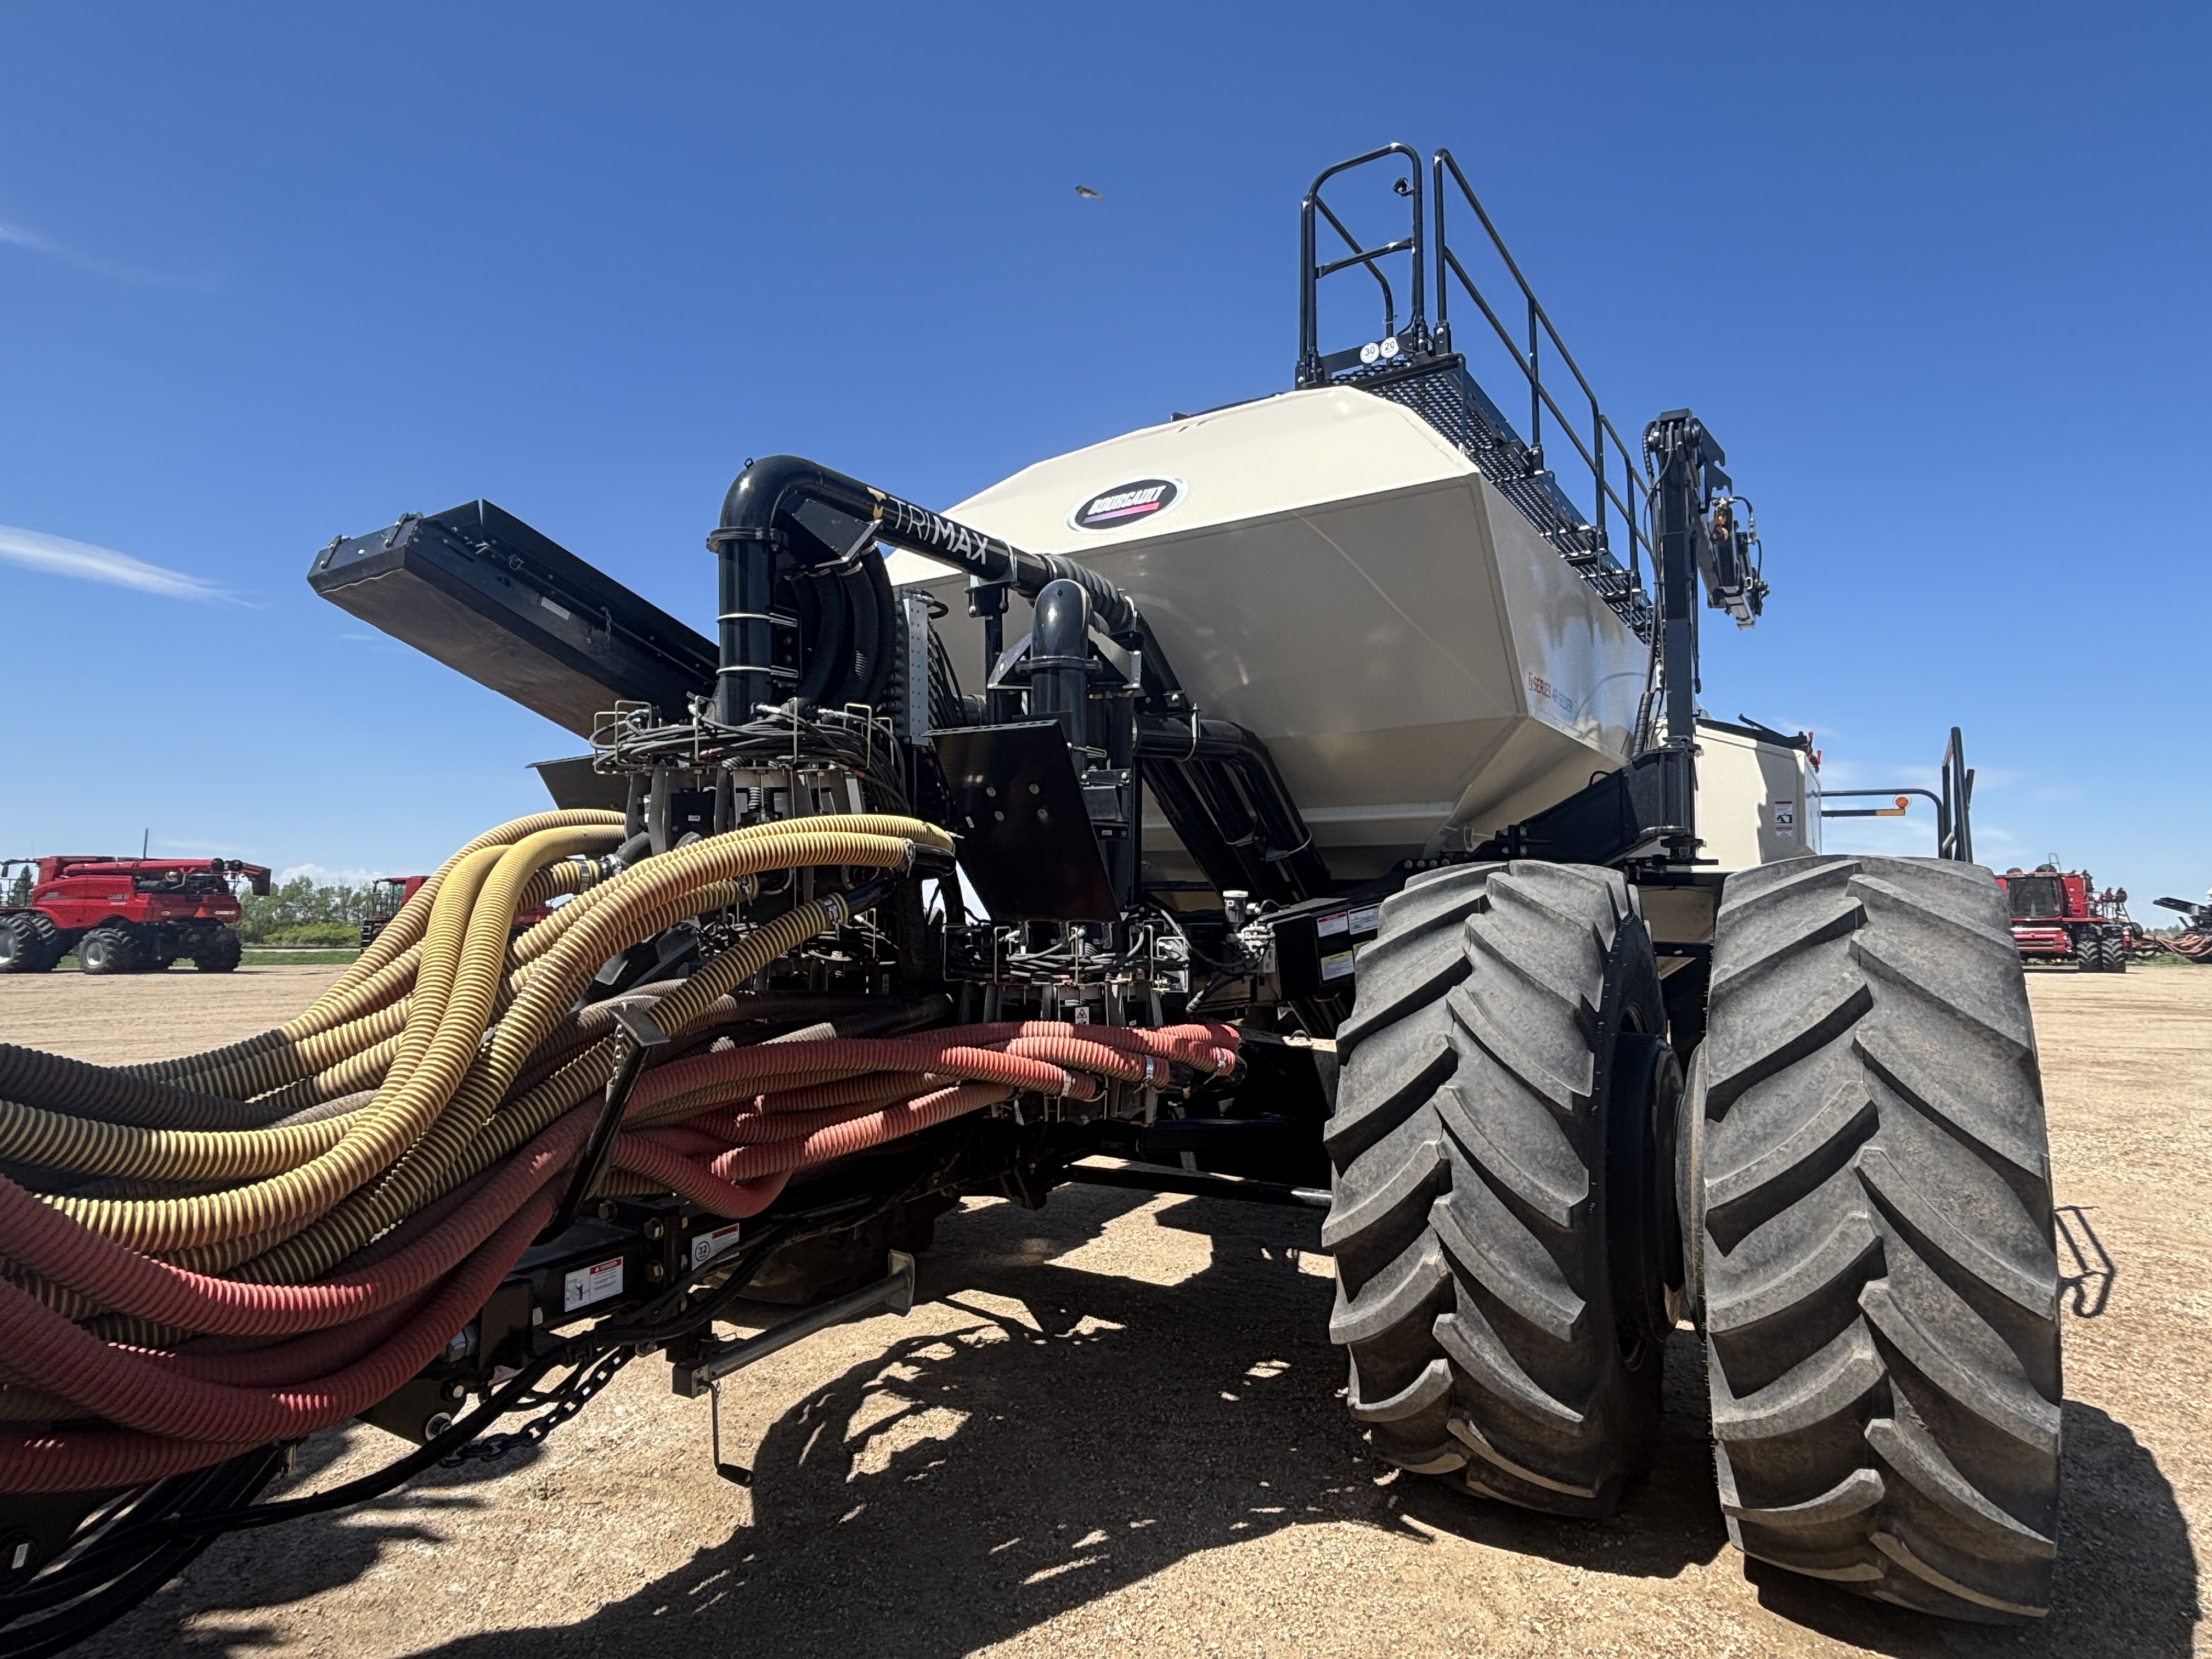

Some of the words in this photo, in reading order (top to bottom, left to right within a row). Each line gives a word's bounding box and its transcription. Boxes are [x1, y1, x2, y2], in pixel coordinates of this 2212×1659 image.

[1364, 346, 1376, 357] 30
[1385, 341, 1395, 351] 20
[1087, 485, 1166, 516] BOURGAULT
[889, 496, 988, 565] TRIMAX
[698, 1245, 707, 1255] 32
